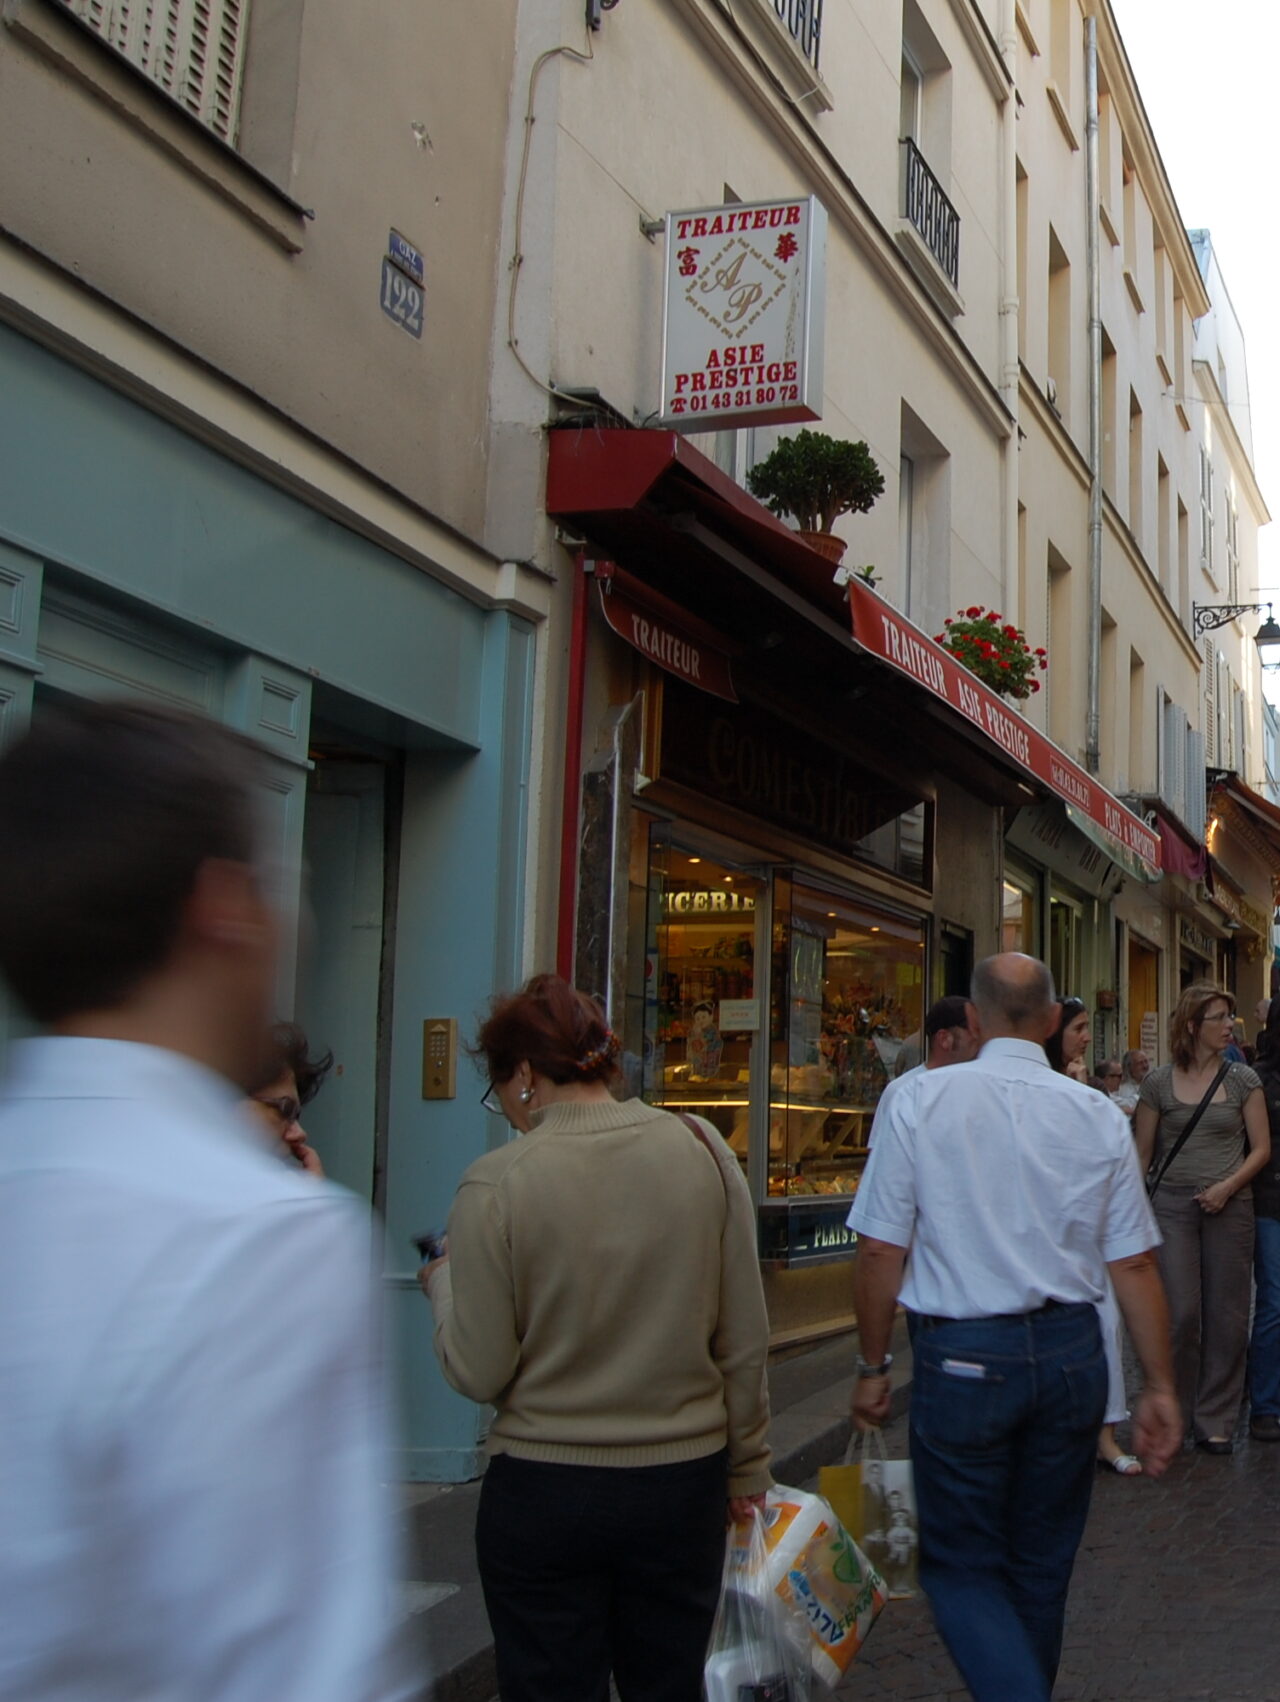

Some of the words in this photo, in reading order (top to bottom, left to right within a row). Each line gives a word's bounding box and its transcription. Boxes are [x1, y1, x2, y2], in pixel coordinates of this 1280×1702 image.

[677, 206, 801, 239] TRAITEUR
[677, 246, 701, 277] 富
[700, 251, 748, 294] A
[383, 265, 420, 332] 122
[723, 282, 763, 324] P
[706, 344, 765, 369] ASIE
[675, 361, 797, 394] PRESTIGE
[690, 395, 707, 412] 01
[711, 392, 731, 409] 43
[735, 390, 751, 406] 31
[756, 387, 775, 404] 80
[780, 385, 798, 402] 72
[631, 613, 701, 680] TRAITEUR
[881, 614, 948, 697] TRAITEUR
[957, 677, 983, 726] ASIE
[985, 701, 1031, 766] PRESTIGE
[1104, 801, 1122, 839] PLATS
[814, 1223, 849, 1247] PLATS
